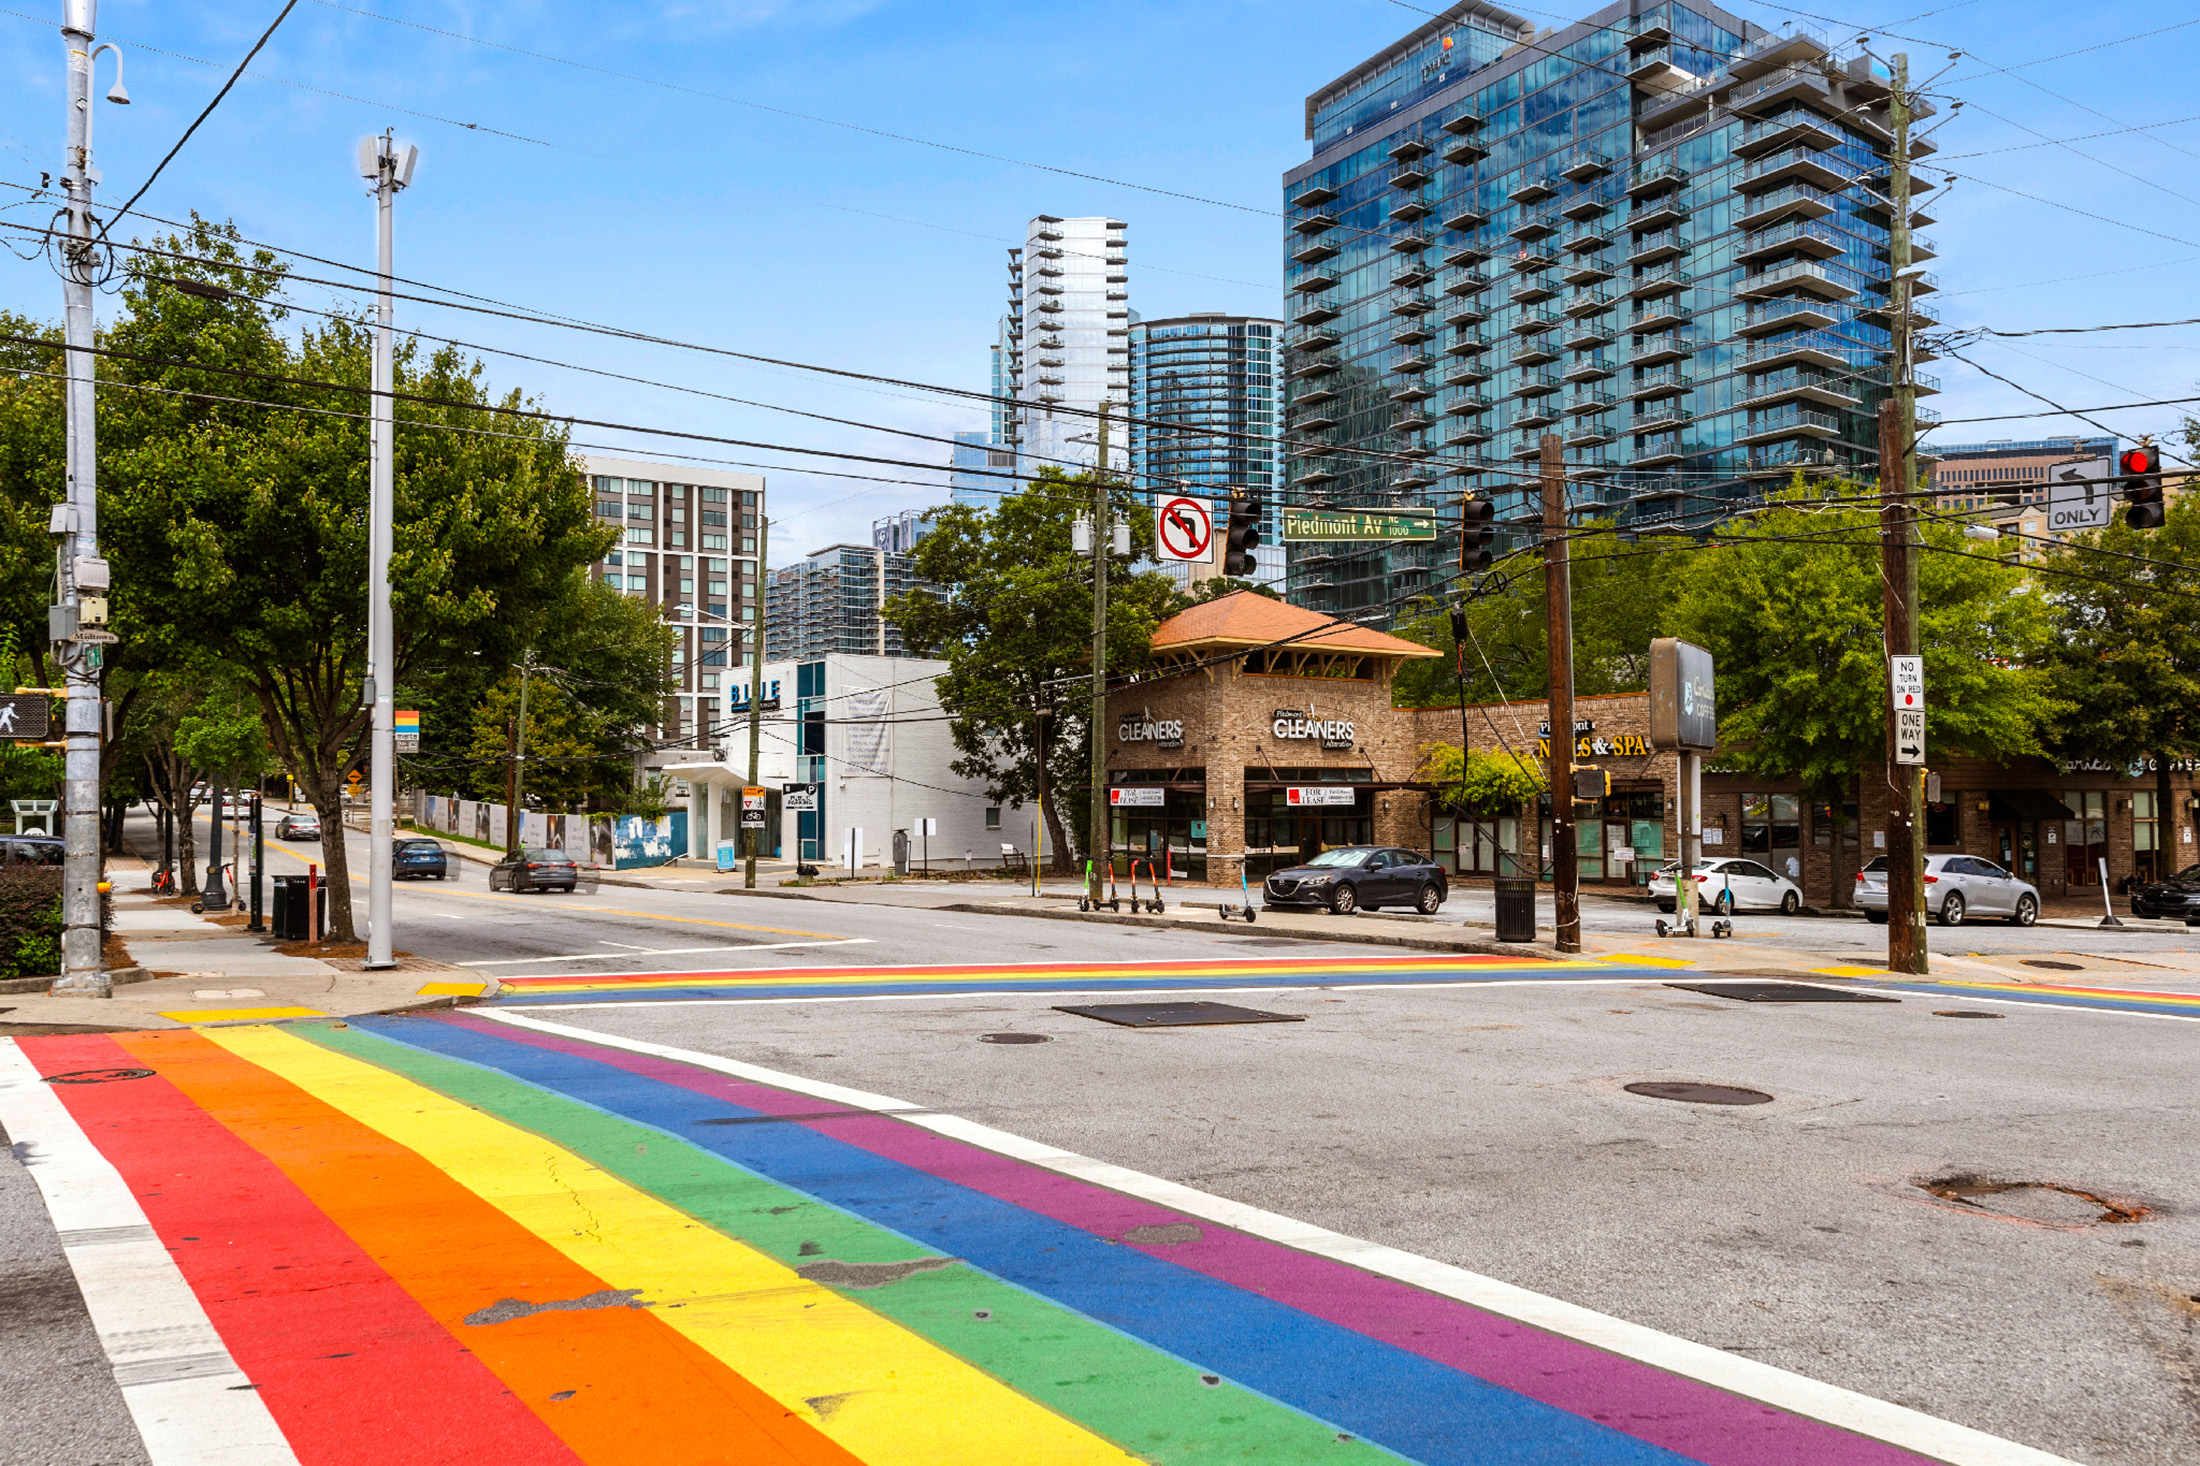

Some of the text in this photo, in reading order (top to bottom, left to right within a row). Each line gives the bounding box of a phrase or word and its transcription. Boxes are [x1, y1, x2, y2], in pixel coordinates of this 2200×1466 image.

[1388, 515, 1399, 524] NE
[2054, 508, 2102, 525] ONLY
[1287, 514, 1383, 535] Piedmont Av
[1389, 525, 1409, 536] 1000
[74, 633, 115, 641] Midtown
[1900, 662, 1914, 672] NO
[1899, 674, 1917, 682] TURN
[1896, 685, 1921, 694] ON RED
[1540, 720, 1589, 732] Piont
[1901, 714, 1921, 727] ONE
[1119, 720, 1183, 742] CLEANERS
[1273, 719, 1354, 739] CLEANERS
[1900, 728, 1921, 741] WAY
[1539, 735, 1647, 758] NLS & SPA
[1306, 788, 1321, 796] FOR
